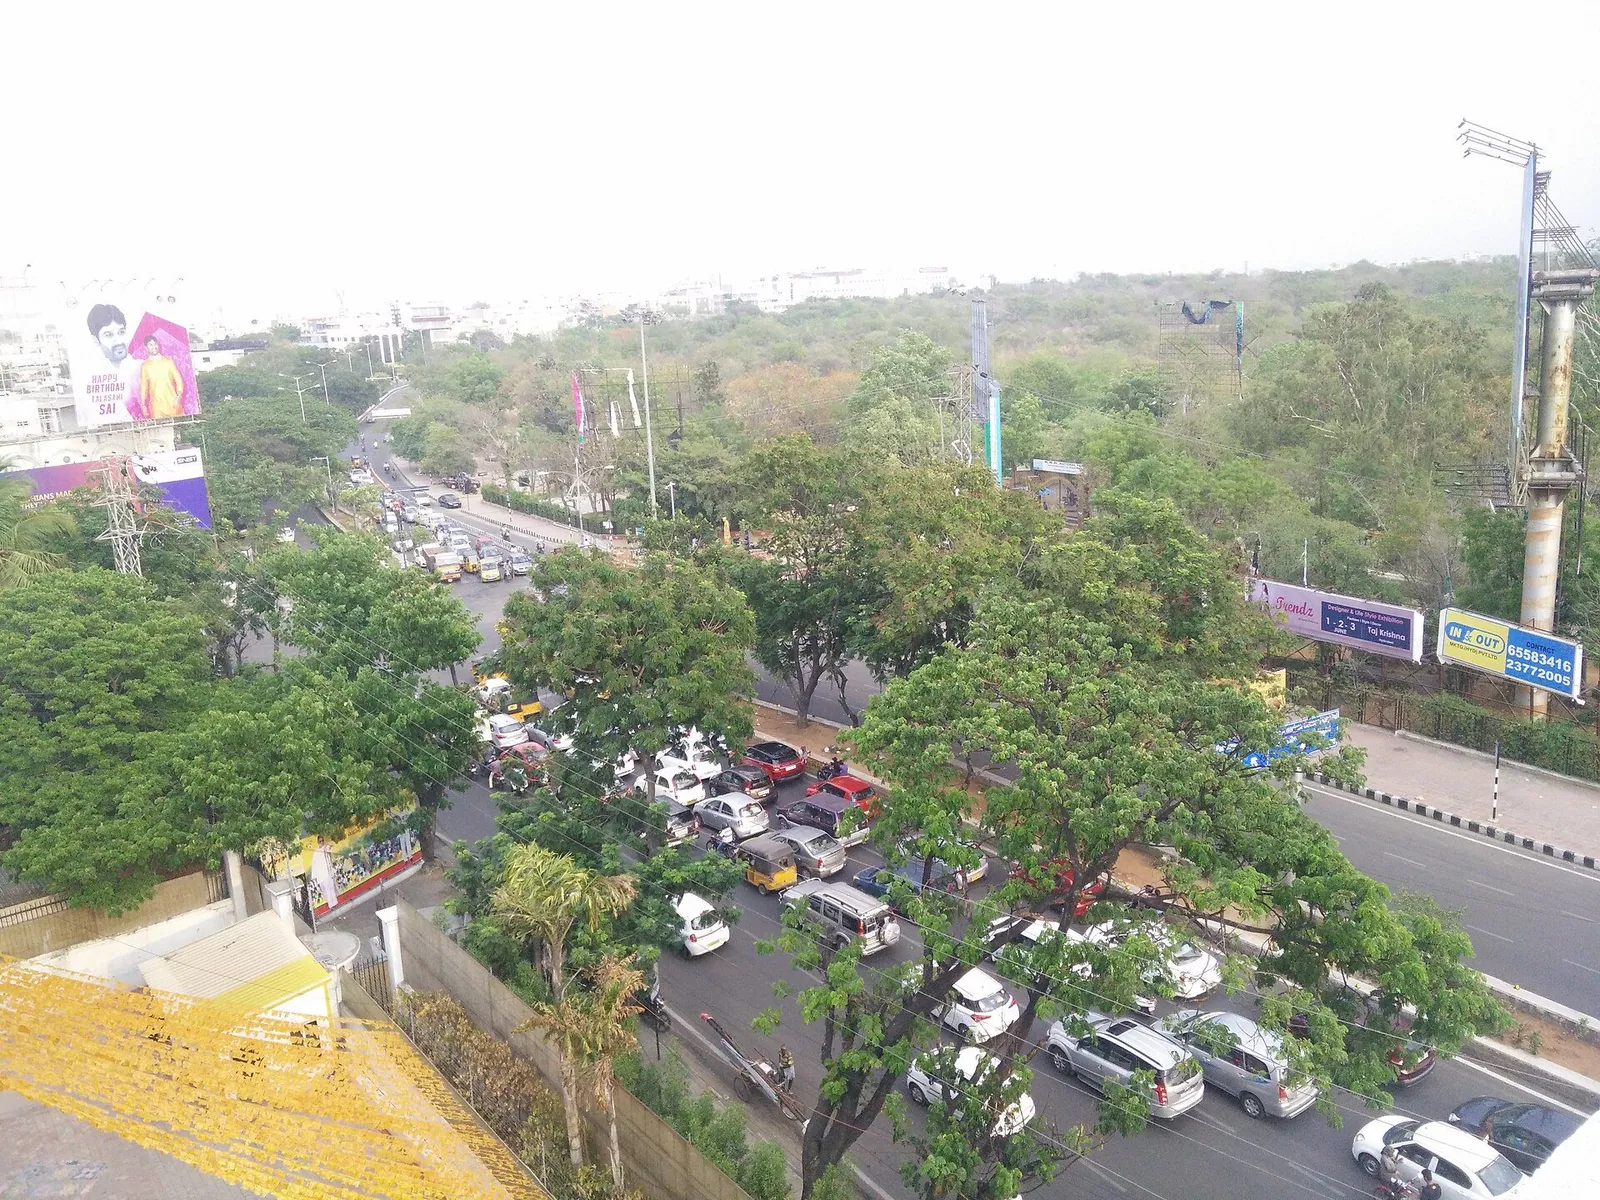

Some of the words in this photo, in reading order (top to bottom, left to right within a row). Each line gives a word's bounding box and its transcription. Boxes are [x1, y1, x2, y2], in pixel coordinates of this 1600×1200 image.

[91, 373, 118, 384] HAPPY
[86, 382, 125, 394] BIRTHDAY
[99, 402, 116, 415] SAI
[1276, 596, 1314, 617] Trendz
[1327, 604, 1349, 614] Designer
[1364, 611, 1377, 620] Style
[1378, 614, 1404, 625] Exhibition
[1333, 627, 1347, 635] JUNE
[1367, 626, 1378, 636] Taj
[1379, 629, 1406, 641] Krishna
[1450, 626, 1462, 638] IN
[1463, 630, 1472, 642] &
[1476, 634, 1500, 649] OUT
[1526, 641, 1555, 655] CONTACT
[1507, 644, 1572, 673] 65583416
[1506, 659, 1571, 686] 23772005
